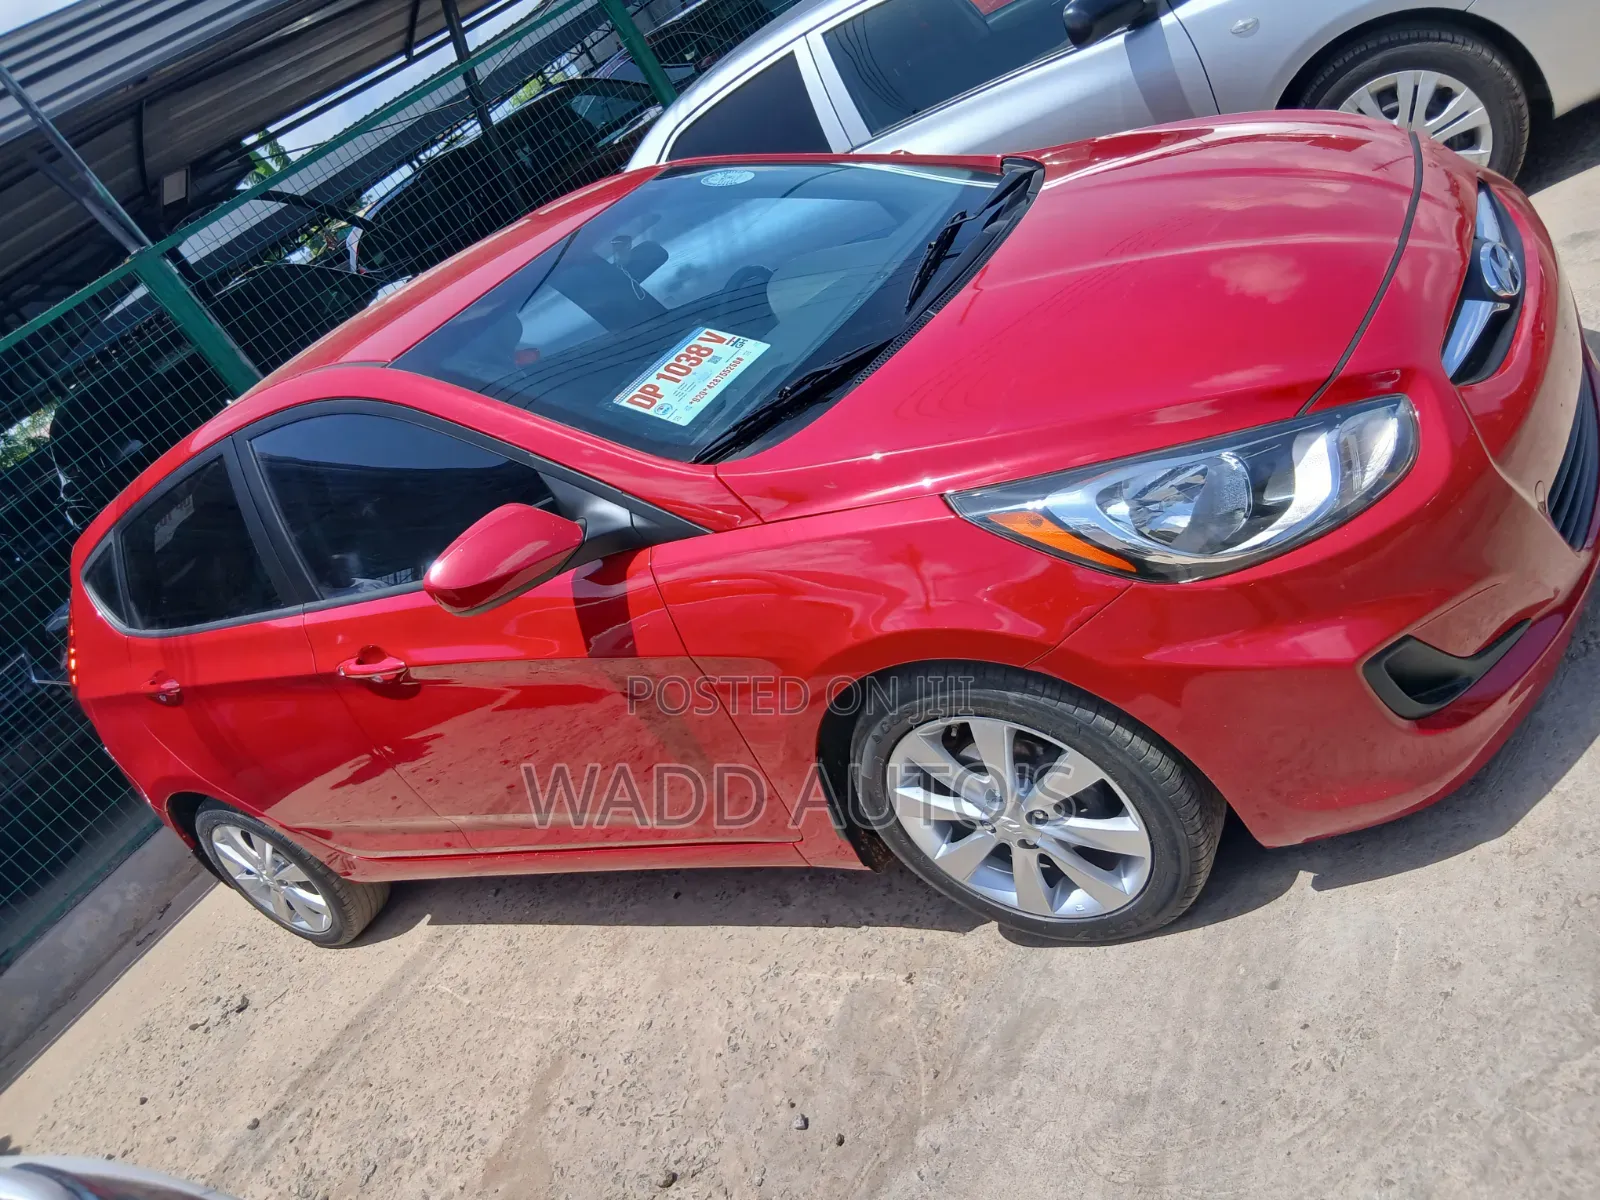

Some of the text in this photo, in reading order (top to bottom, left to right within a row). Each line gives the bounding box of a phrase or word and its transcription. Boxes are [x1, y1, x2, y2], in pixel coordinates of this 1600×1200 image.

[735, 338, 749, 348] GH
[626, 383, 665, 409] DP
[656, 344, 714, 383] 1038
[697, 330, 728, 344] V
